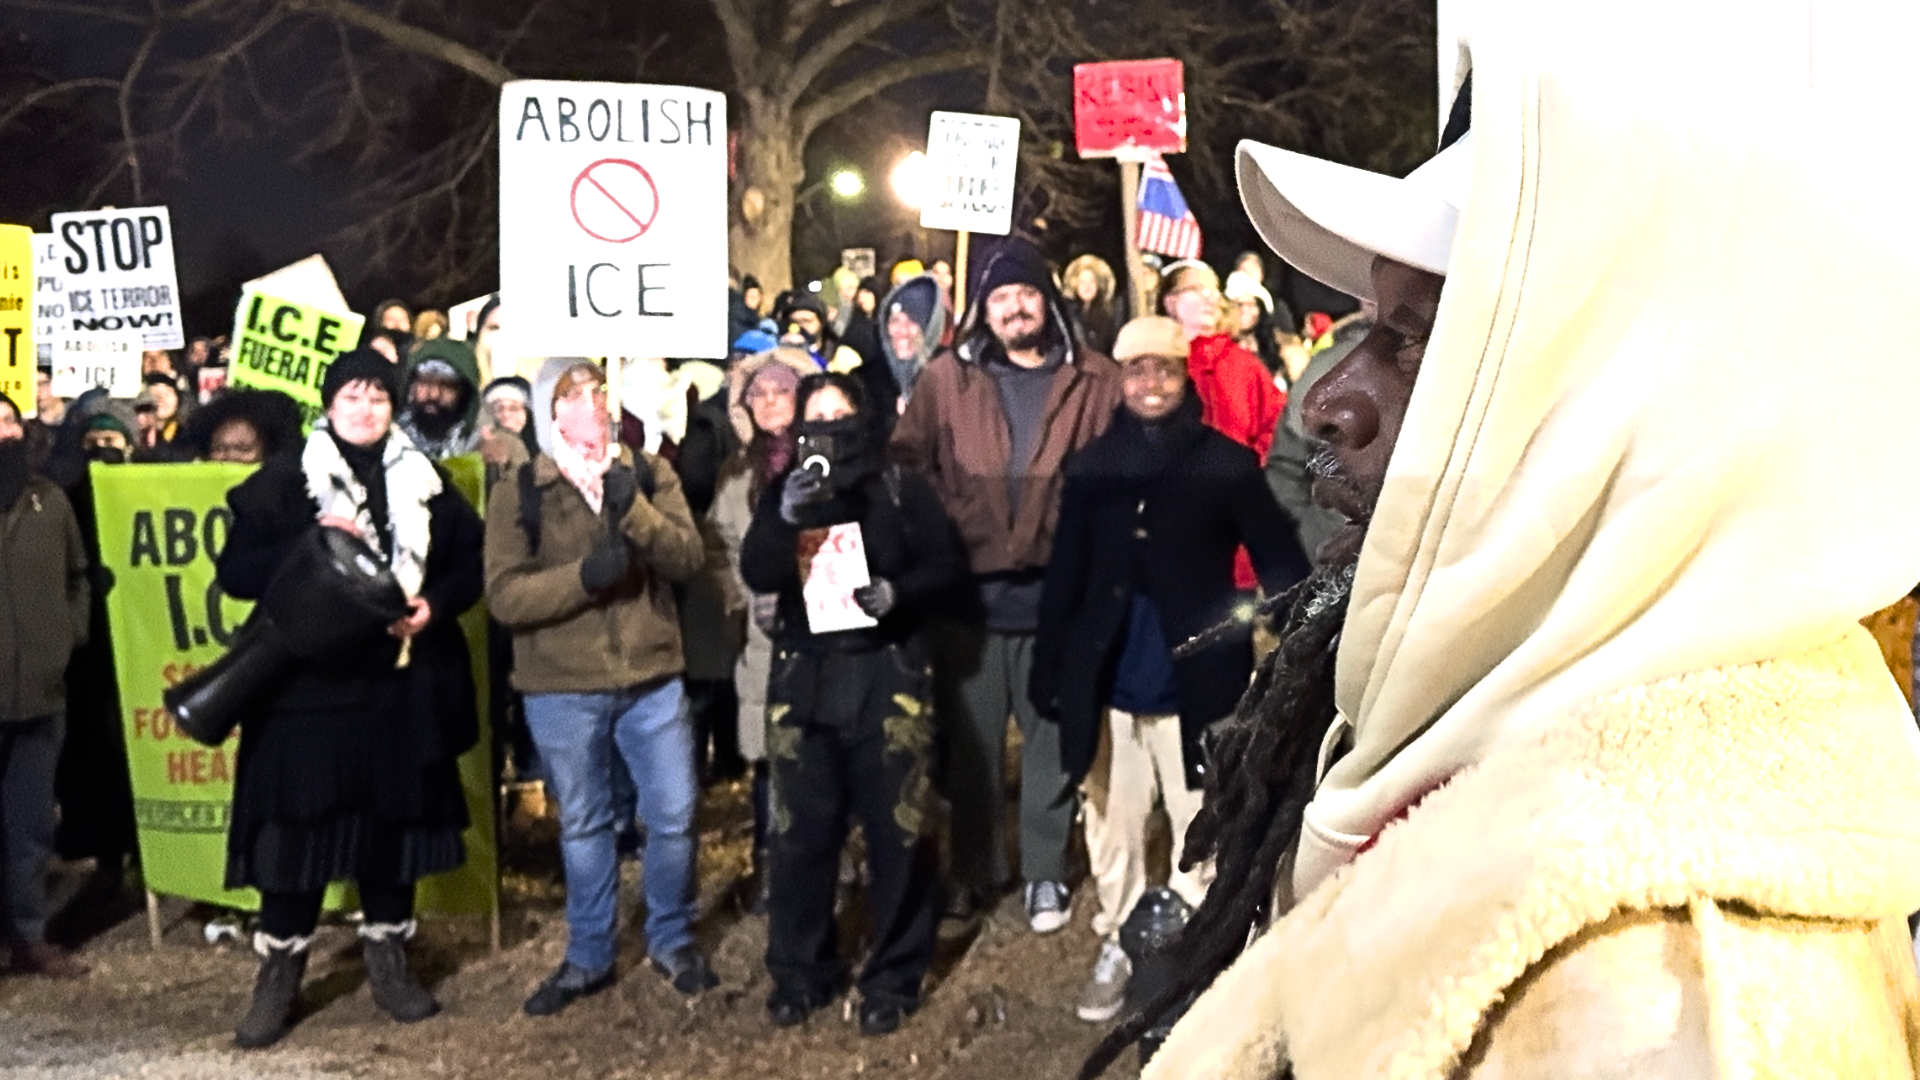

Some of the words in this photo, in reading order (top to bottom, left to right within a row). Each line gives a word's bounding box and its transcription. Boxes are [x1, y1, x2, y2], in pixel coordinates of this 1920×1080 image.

[516, 96, 712, 146] ABOLISH
[61, 215, 163, 275] STOP
[101, 284, 172, 310] TERROR
[568, 262, 674, 318] ICE
[73, 312, 173, 331] NOW!
[238, 337, 310, 386] FUERA
